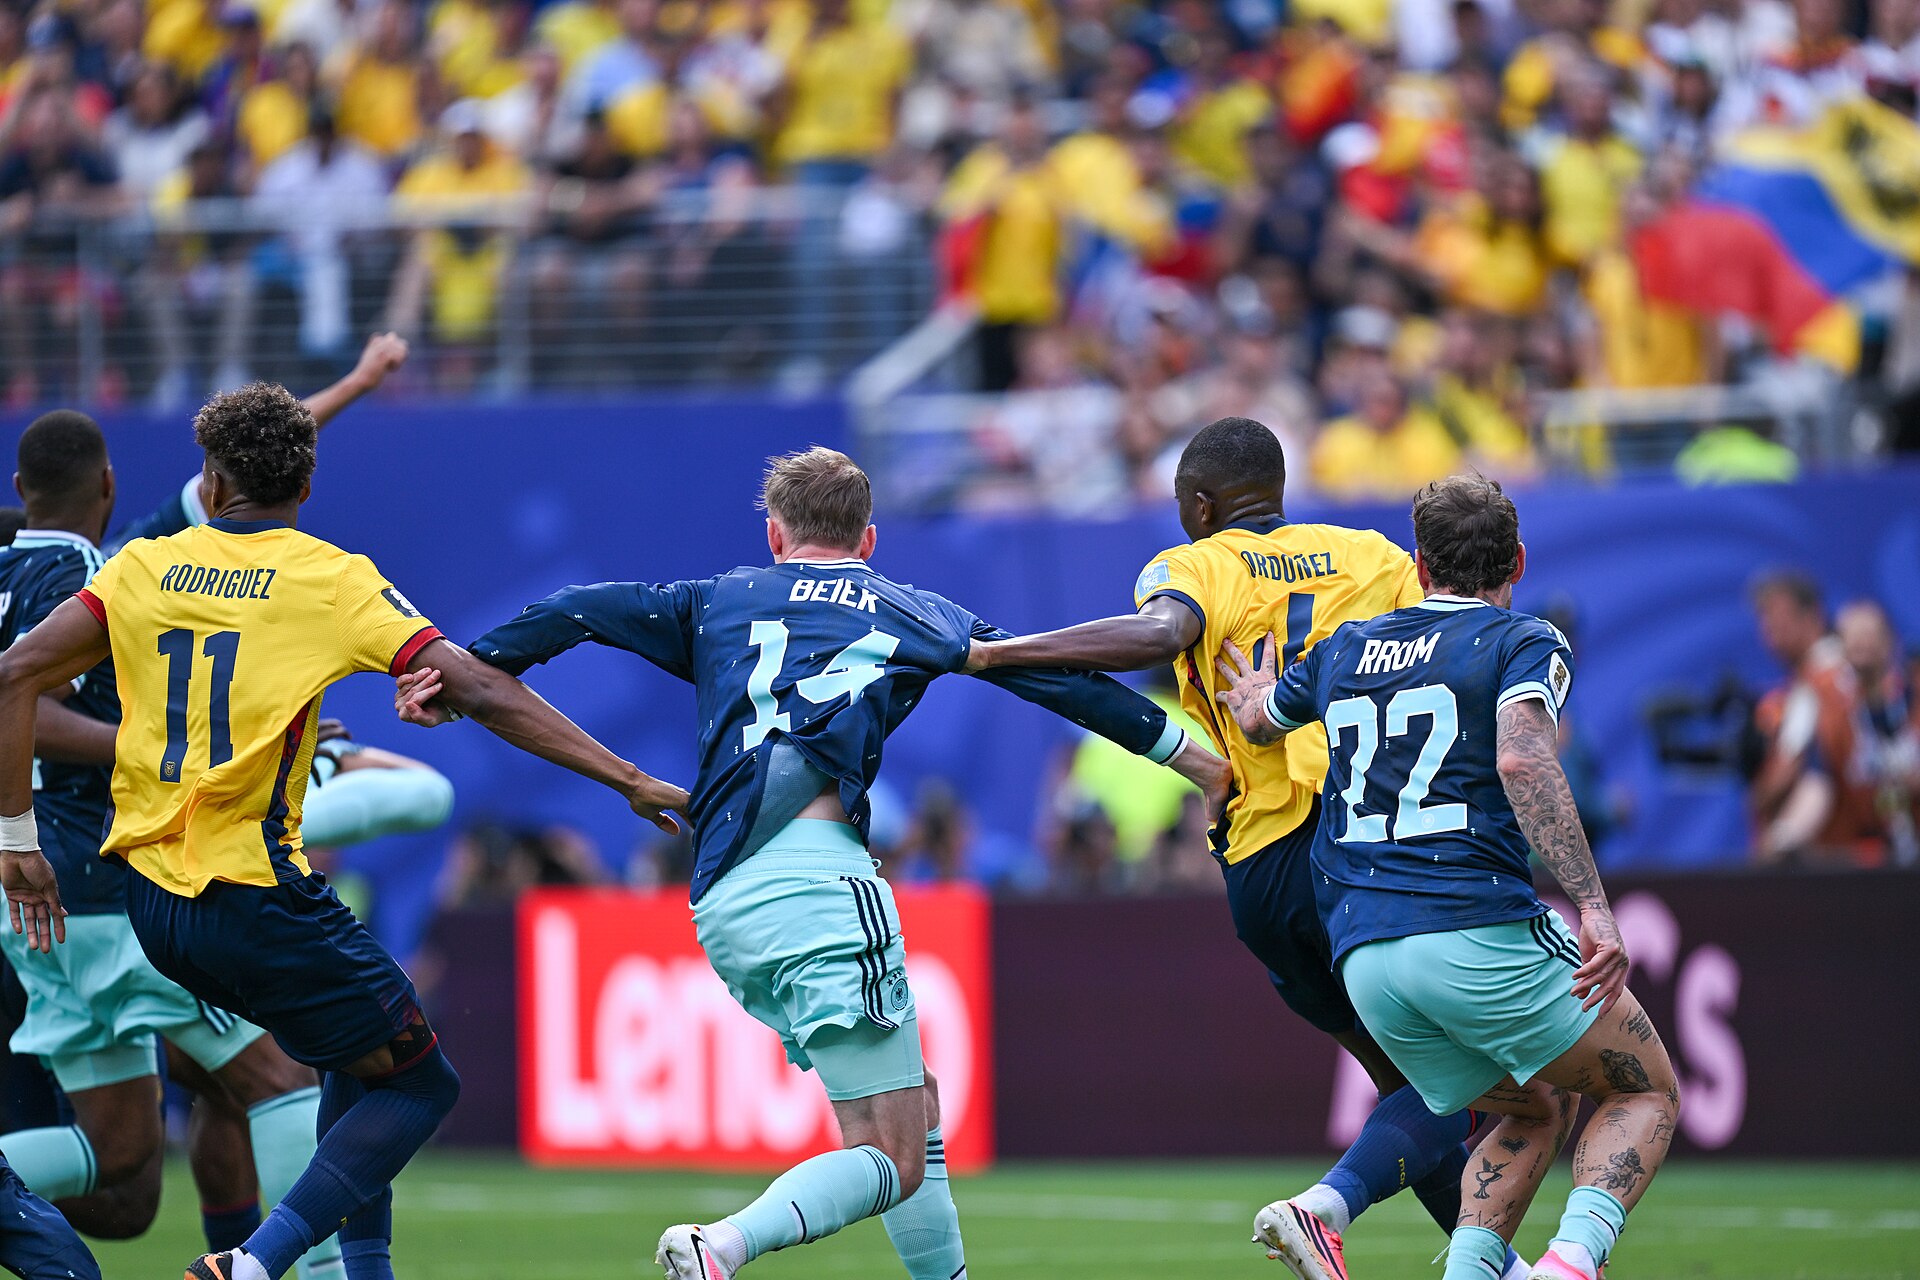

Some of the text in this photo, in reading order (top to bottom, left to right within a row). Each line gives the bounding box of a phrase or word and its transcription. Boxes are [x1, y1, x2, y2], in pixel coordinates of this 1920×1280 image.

[160, 563, 277, 600] RODRIGUEZ
[788, 577, 880, 614] BEIER
[1240, 550, 1338, 584] ORDOÑEZ
[742, 620, 901, 752] 14
[1354, 631, 1442, 675] RAUM
[157, 628, 241, 784] 11
[1324, 683, 1468, 843] 22
[533, 906, 972, 1152] Lenoo
